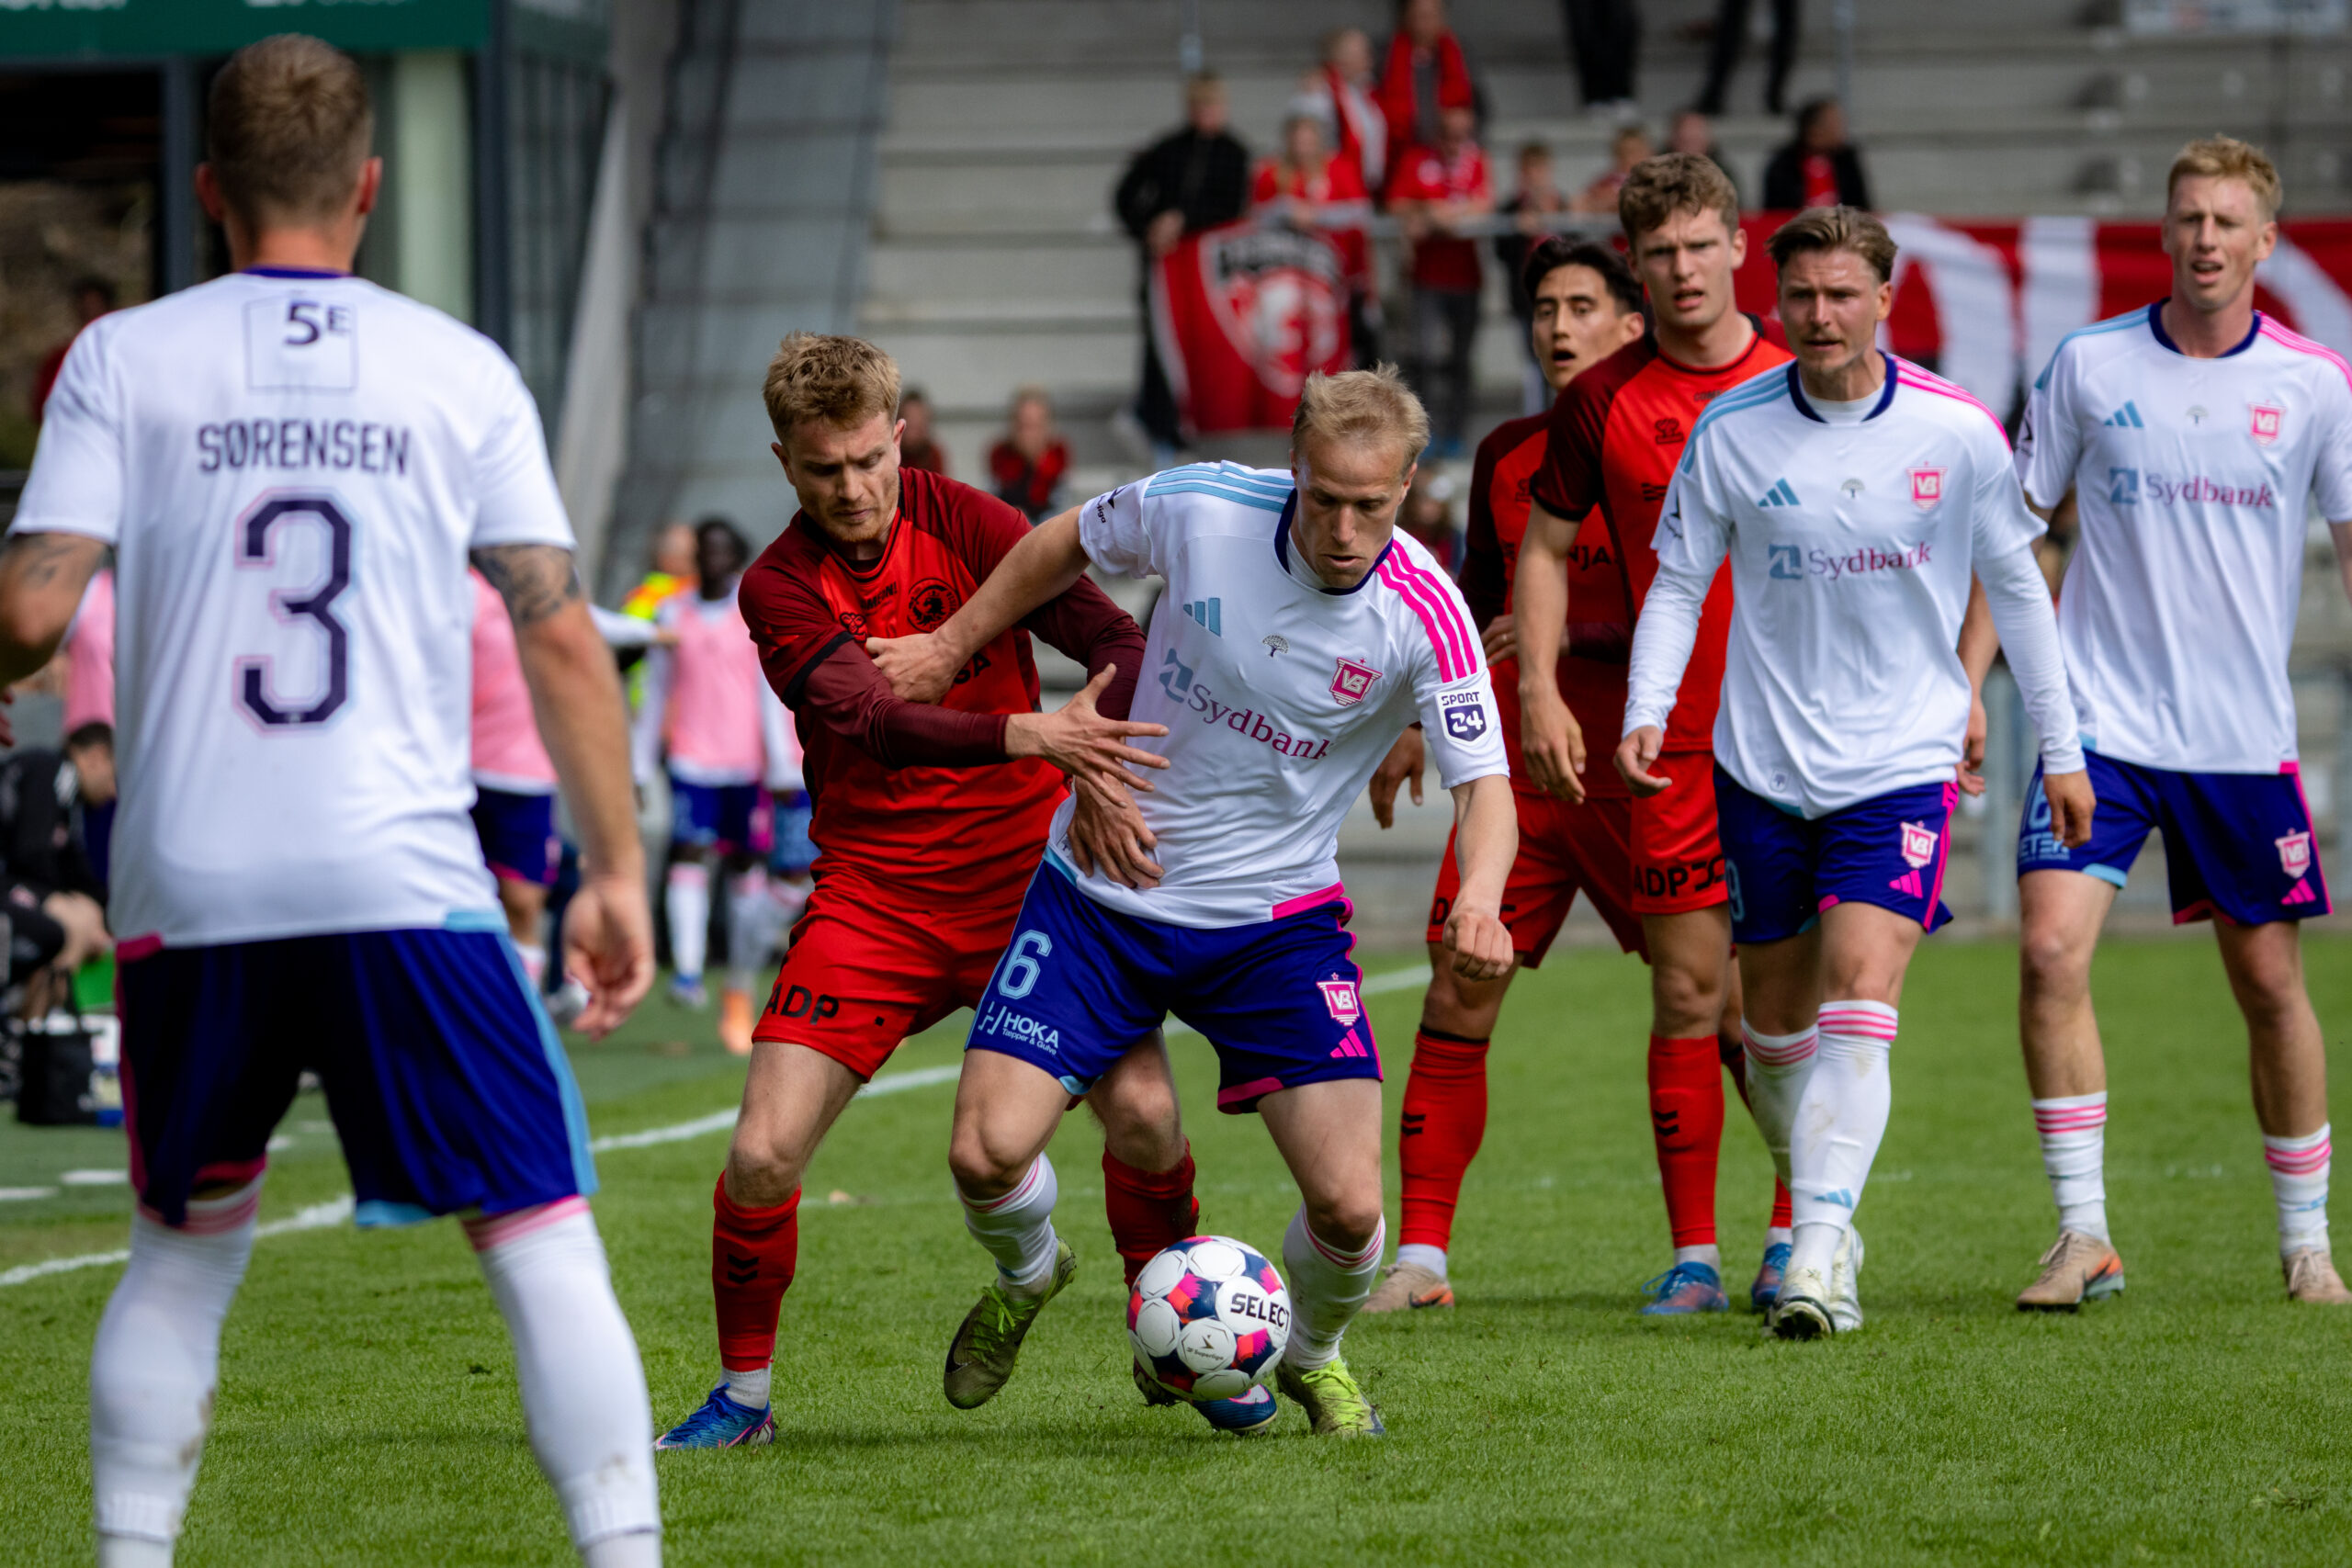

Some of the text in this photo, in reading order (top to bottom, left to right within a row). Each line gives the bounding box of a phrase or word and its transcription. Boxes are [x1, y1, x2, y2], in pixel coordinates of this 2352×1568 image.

[198, 418, 411, 476] SØRENSEN
[2146, 473, 2273, 508] Sydbank
[233, 486, 362, 737] 3
[1441, 691, 1480, 706] SPORT
[1450, 710, 1484, 733] 24
[1634, 864, 1689, 897] ADP
[998, 929, 1053, 1000] 6
[1003, 1011, 1059, 1049] HOKA
[1230, 1292, 1290, 1332] SELECT
